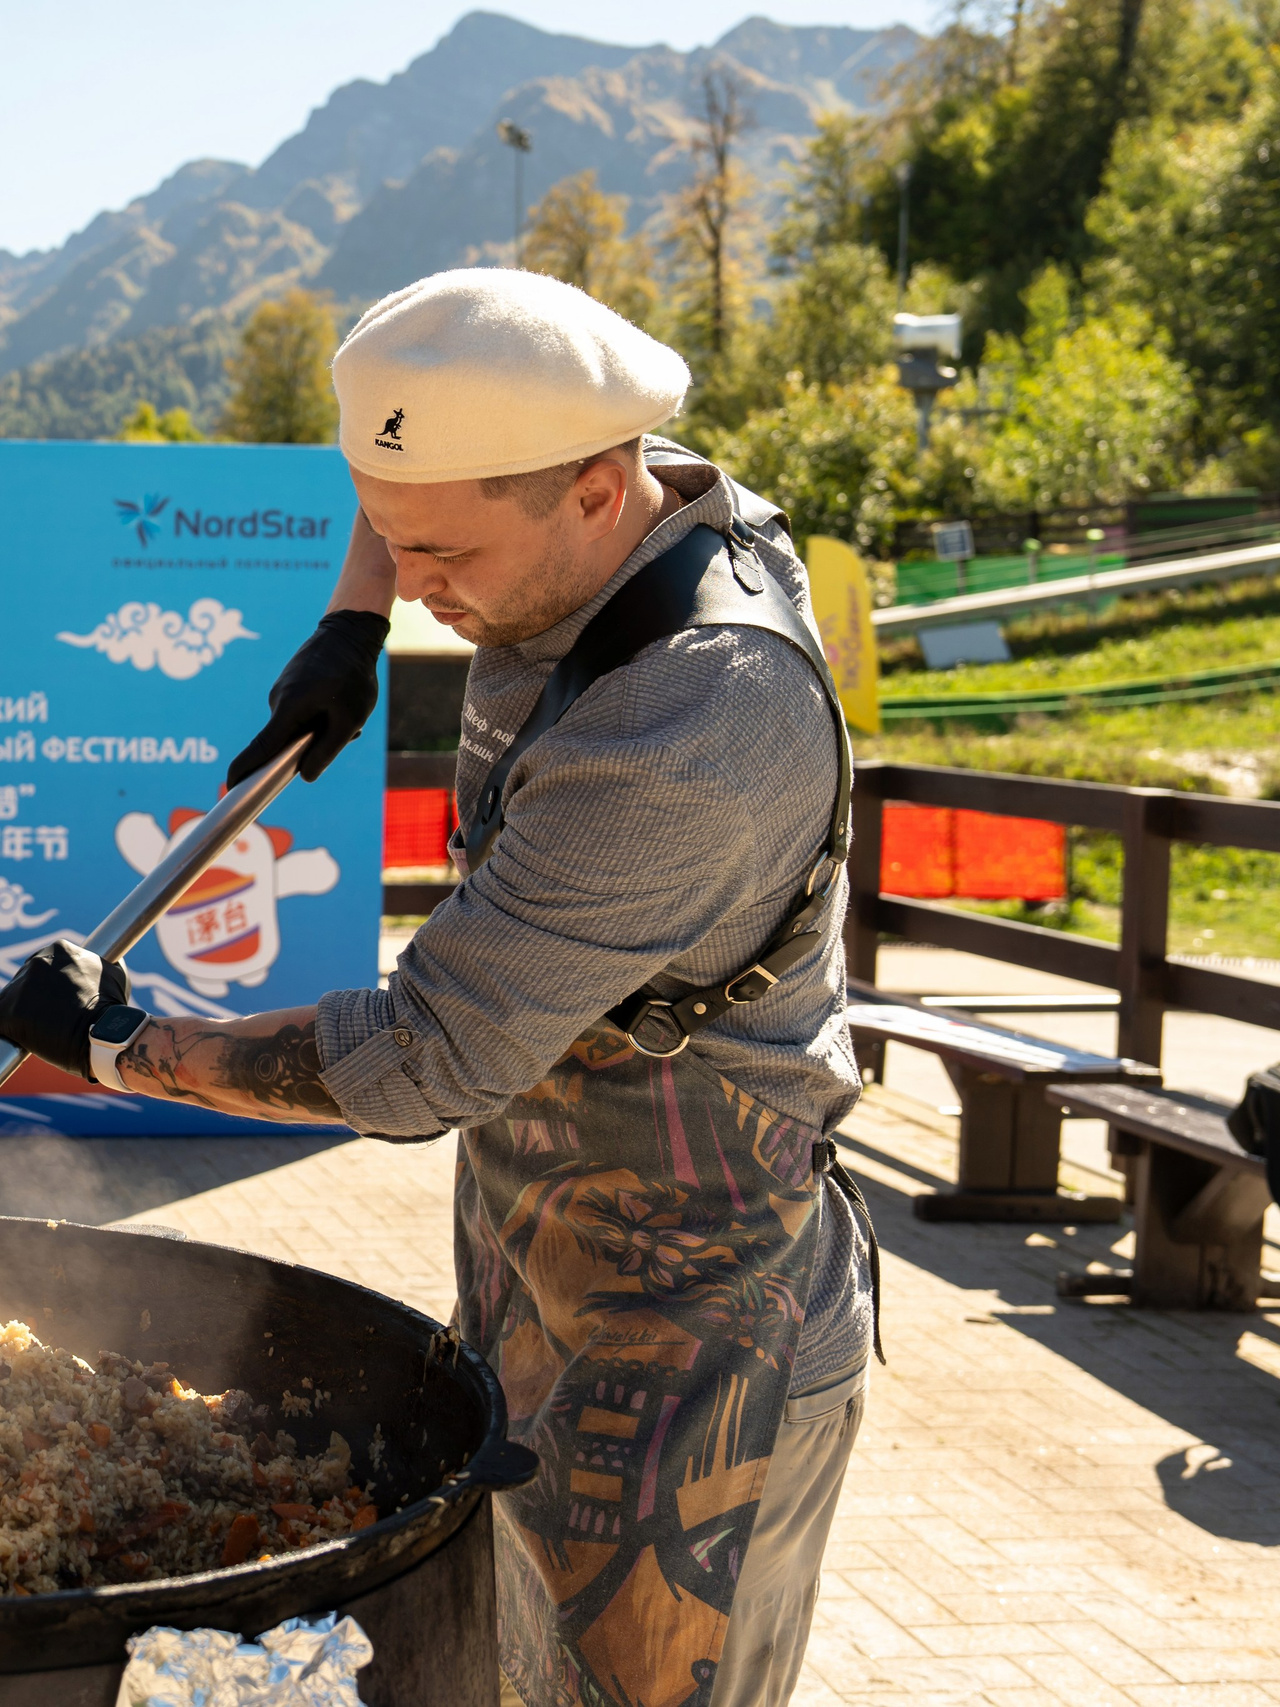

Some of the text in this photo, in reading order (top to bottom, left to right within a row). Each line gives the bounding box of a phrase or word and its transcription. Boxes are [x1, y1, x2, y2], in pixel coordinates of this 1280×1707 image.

[374, 438, 404, 452] KANGOL
[174, 508, 332, 540] NordStar
[465, 703, 488, 733] Шеф
[41, 735, 220, 764] ФЕСТИВАЛЬ
